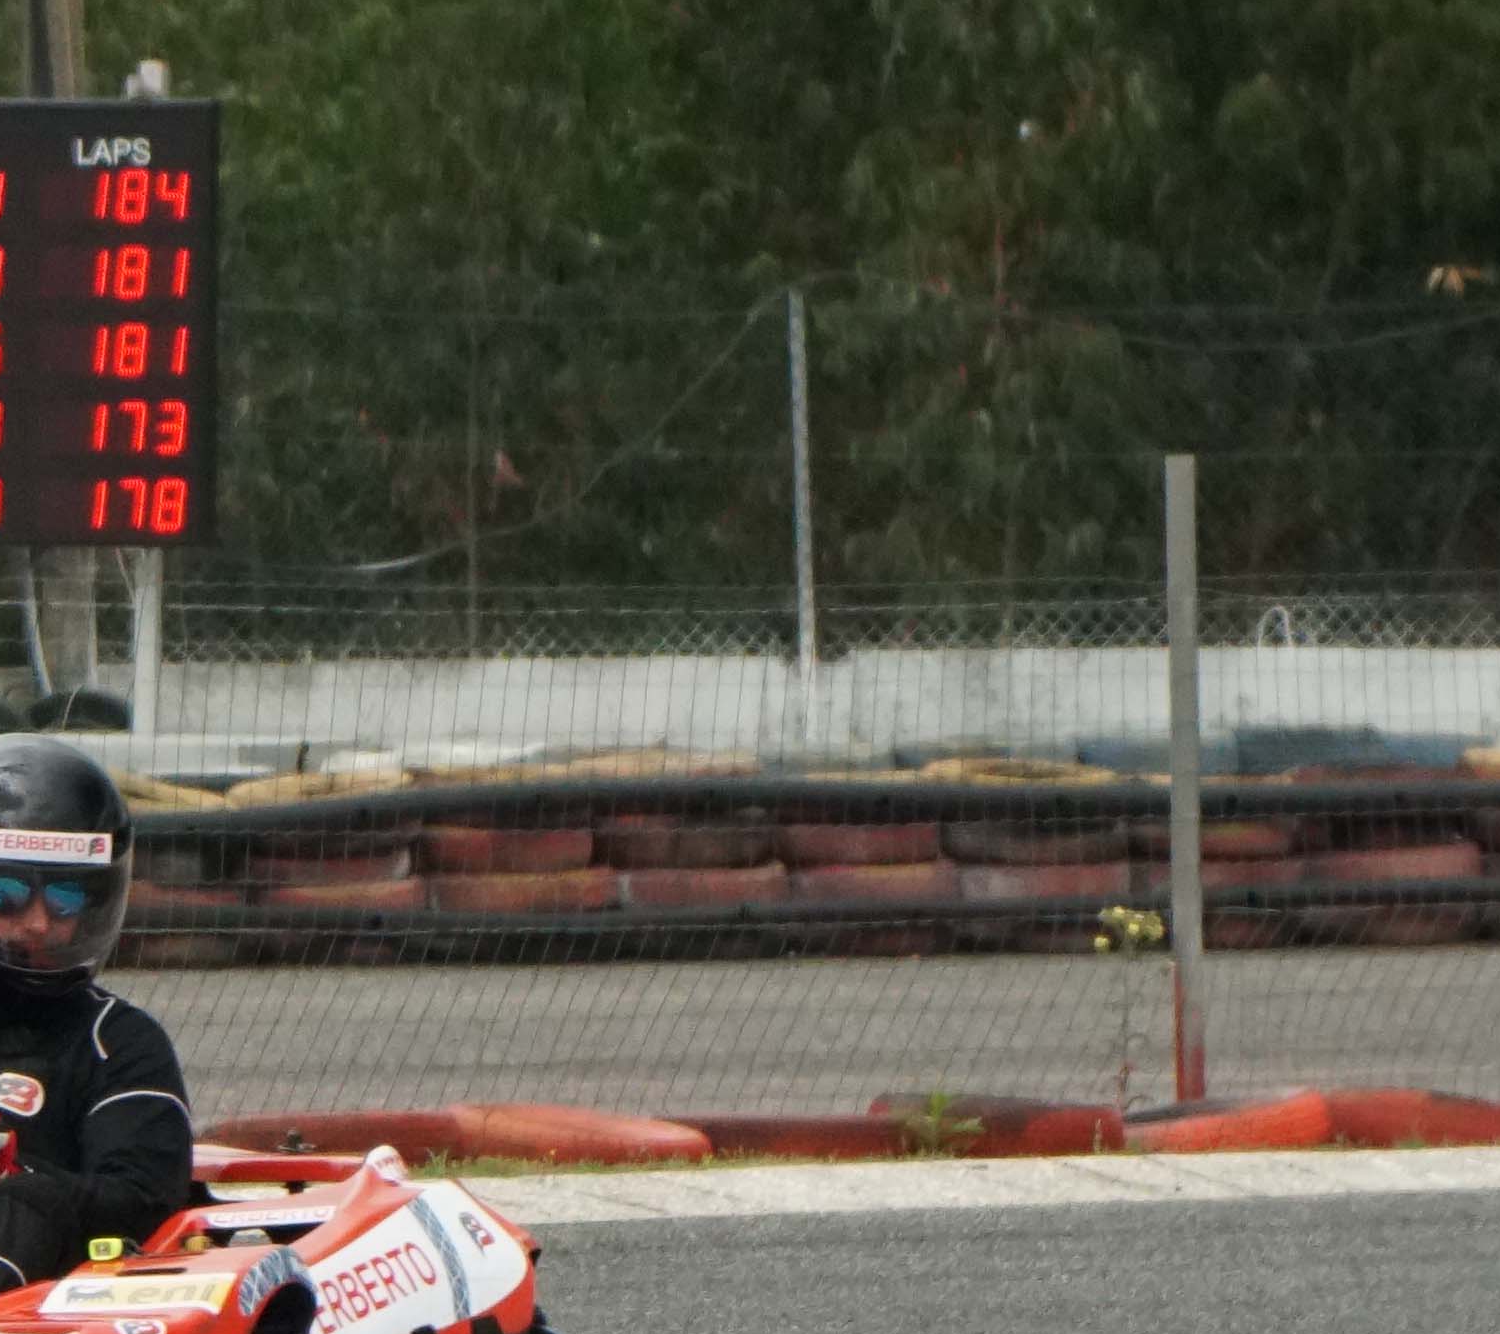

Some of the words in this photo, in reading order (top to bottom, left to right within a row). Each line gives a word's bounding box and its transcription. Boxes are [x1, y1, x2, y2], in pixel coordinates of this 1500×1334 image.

[75, 138, 151, 166] LAPS
[94, 168, 190, 224] 184
[93, 244, 190, 301] 181
[92, 322, 189, 378] 181
[92, 399, 188, 457] 173
[91, 476, 188, 534] 178
[128, 1283, 216, 1304] eni
[313, 1241, 437, 1334] ERBERTO
